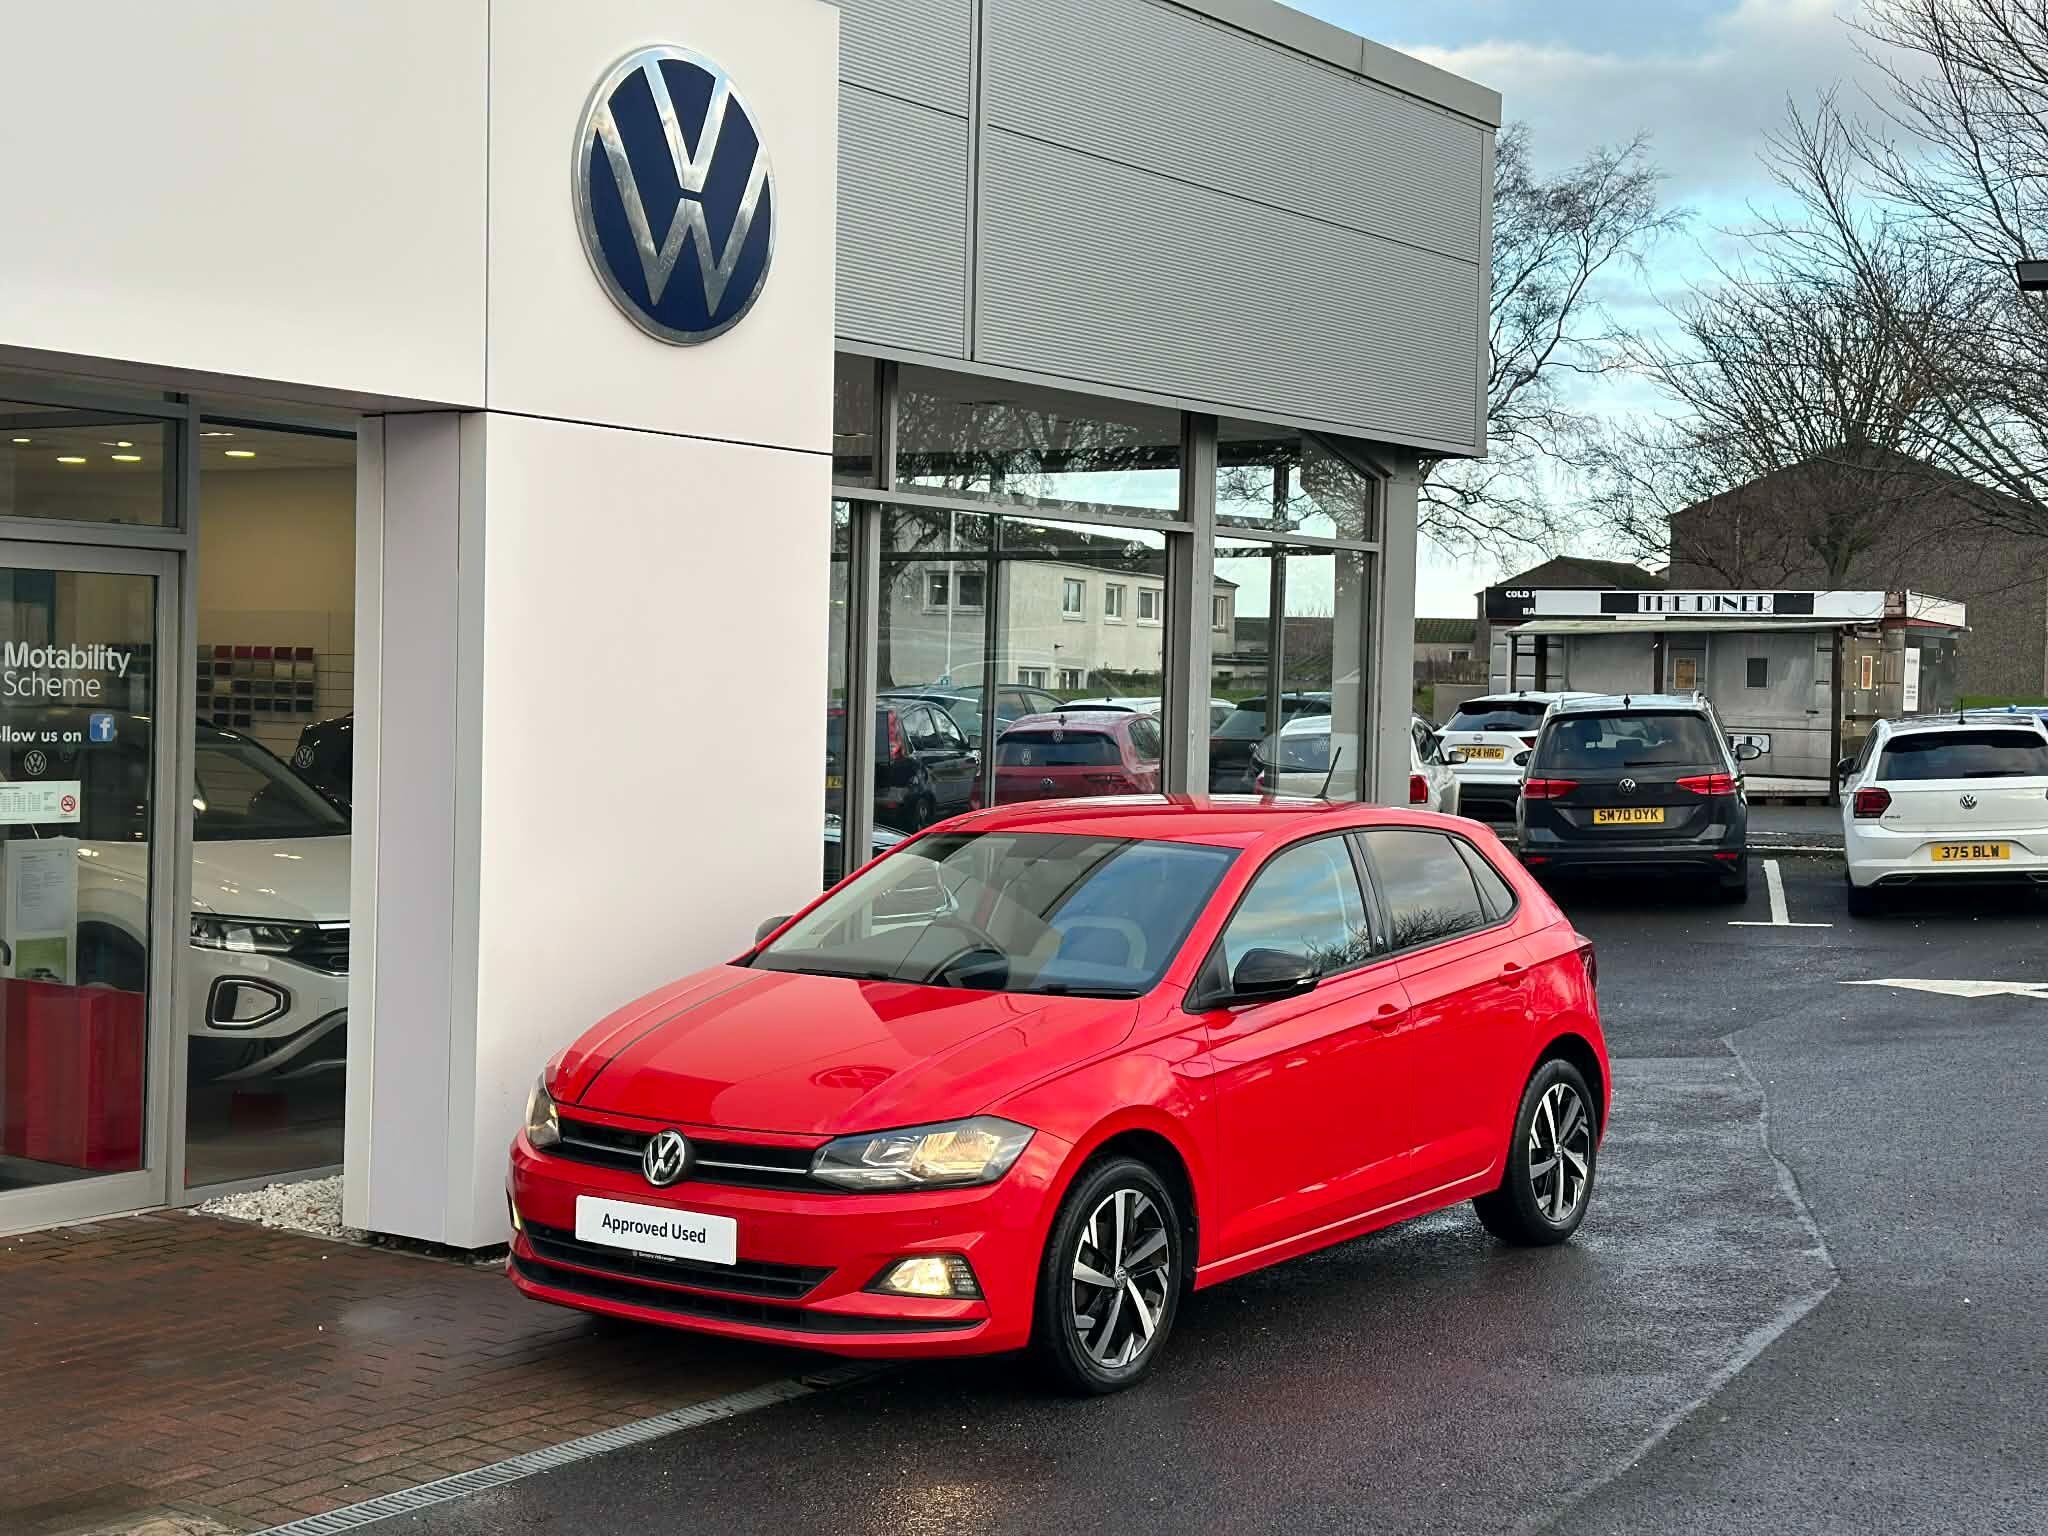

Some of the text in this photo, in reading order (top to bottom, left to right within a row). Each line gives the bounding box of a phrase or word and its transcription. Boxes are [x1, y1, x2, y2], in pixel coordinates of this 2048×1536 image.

[1505, 590, 1530, 598] COLD
[1639, 595, 1773, 612] THE DINER
[4, 640, 132, 678] Motability
[3, 670, 101, 697] Scheme
[0, 725, 82, 742] llow us on
[1599, 809, 1631, 821] SM70
[1942, 846, 2000, 858] 375 BLW
[601, 1213, 706, 1243] Approved Used
